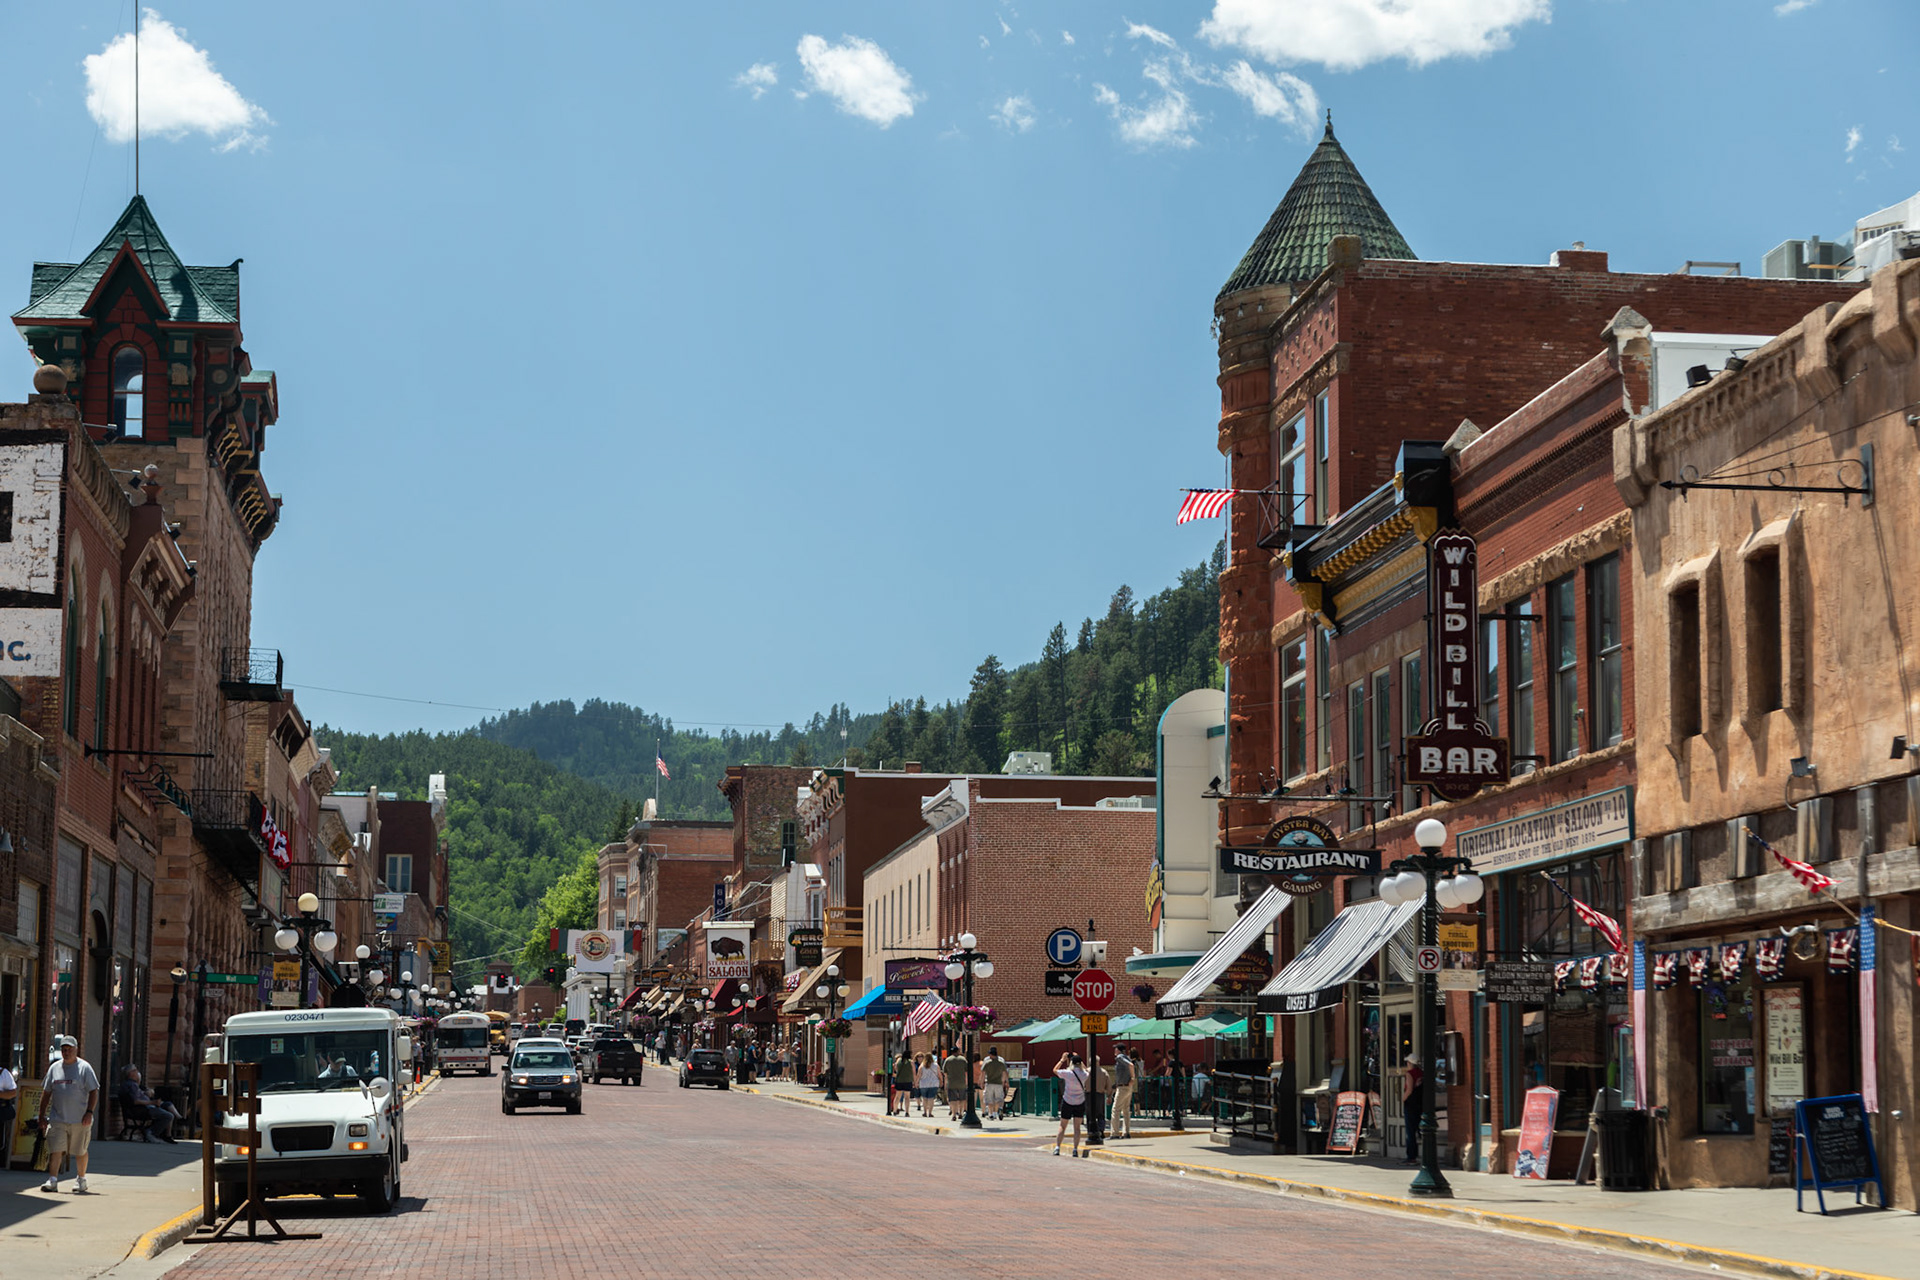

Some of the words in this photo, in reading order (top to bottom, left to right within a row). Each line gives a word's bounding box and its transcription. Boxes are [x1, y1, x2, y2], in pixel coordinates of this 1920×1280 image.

[1443, 546, 1467, 632] WILD
[1446, 644, 1468, 730] BILL
[1420, 746, 1498, 774] BAR
[1272, 820, 1309, 840] OYSTER
[1312, 822, 1332, 841] BAY
[1462, 826, 1507, 858] ORIGINAL
[1508, 813, 1556, 848] LOCATION
[1565, 800, 1603, 833] SALOON
[1612, 794, 1626, 821] 10
[1493, 851, 1516, 865] HISTORIC
[1518, 848, 1531, 860] SPOT
[1541, 843, 1552, 854] THE
[1566, 836, 1579, 848] WEST
[1233, 852, 1370, 871] RESTAURANT
[1282, 880, 1322, 894] GAMING
[1057, 934, 1077, 960] P
[708, 966, 749, 977] SALOON
[1490, 971, 1515, 979] SALOON
[1494, 964, 1529, 972] HISTORIC
[1530, 964, 1546, 972] SITE
[1047, 986, 1063, 994] Public
[1075, 982, 1113, 998] STOP
[285, 1013, 324, 1021] 0230471
[1823, 1111, 1845, 1119] LIGHT
